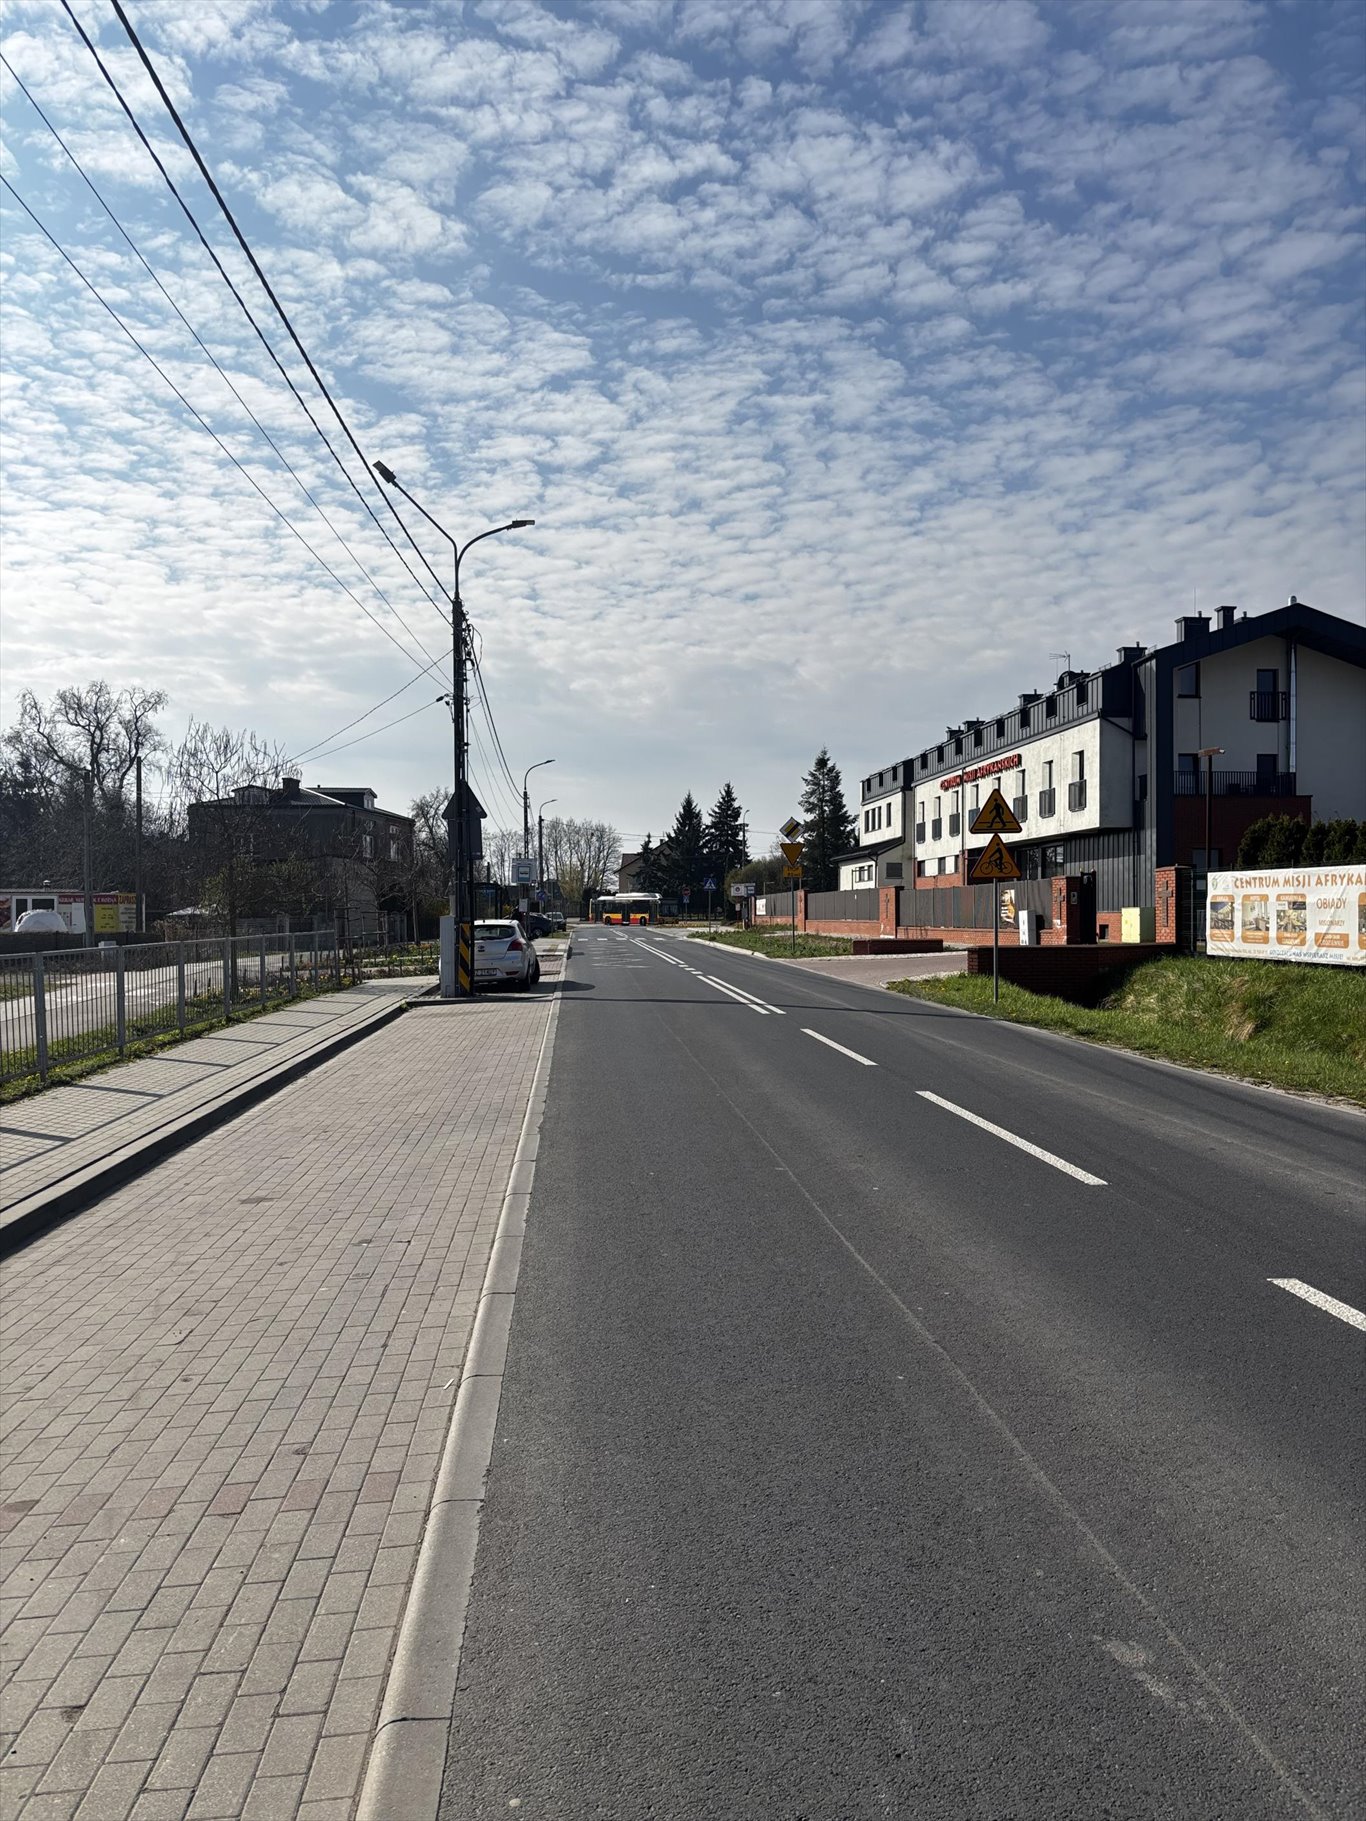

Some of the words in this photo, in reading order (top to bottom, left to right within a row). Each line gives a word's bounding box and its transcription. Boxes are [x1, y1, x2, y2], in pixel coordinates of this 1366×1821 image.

[1234, 876, 1280, 889] CENTRUM
[1283, 874, 1311, 888] MISJI
[1315, 871, 1366, 887] AFRYKA
[1316, 897, 1347, 910] OBIADY
